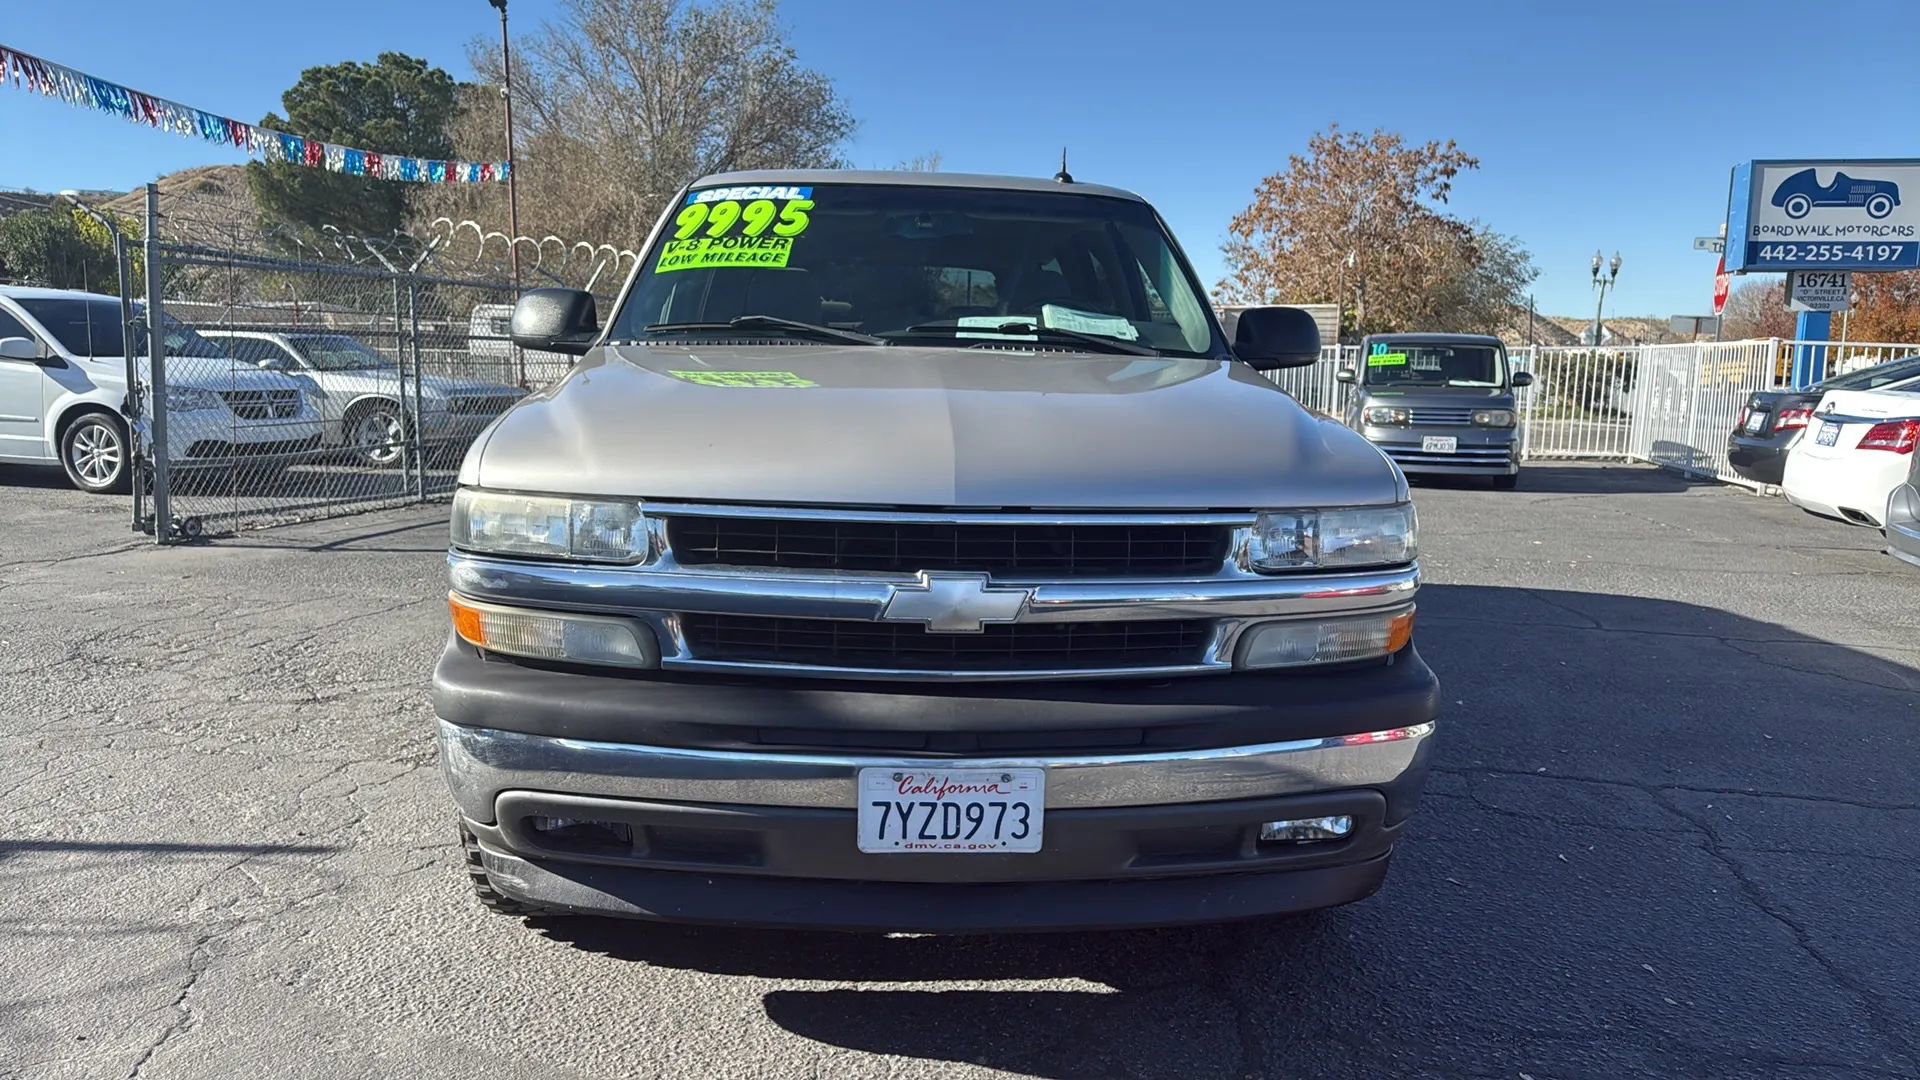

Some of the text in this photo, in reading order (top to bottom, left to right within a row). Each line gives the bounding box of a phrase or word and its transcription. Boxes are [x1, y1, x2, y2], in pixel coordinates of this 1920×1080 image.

[695, 186, 804, 203] SPECIAL
[674, 199, 815, 240] 9995
[1835, 225, 1914, 237] MOTORCARS
[667, 237, 789, 254] V-8 POWER
[1760, 245, 1904, 261] 442-255-4197
[659, 252, 785, 268] LOW MILEAGE
[1798, 273, 1847, 288] 16741
[897, 775, 1011, 801] California
[872, 801, 1030, 840] 7YZD973
[904, 842, 997, 850] dmv.ca.gov
